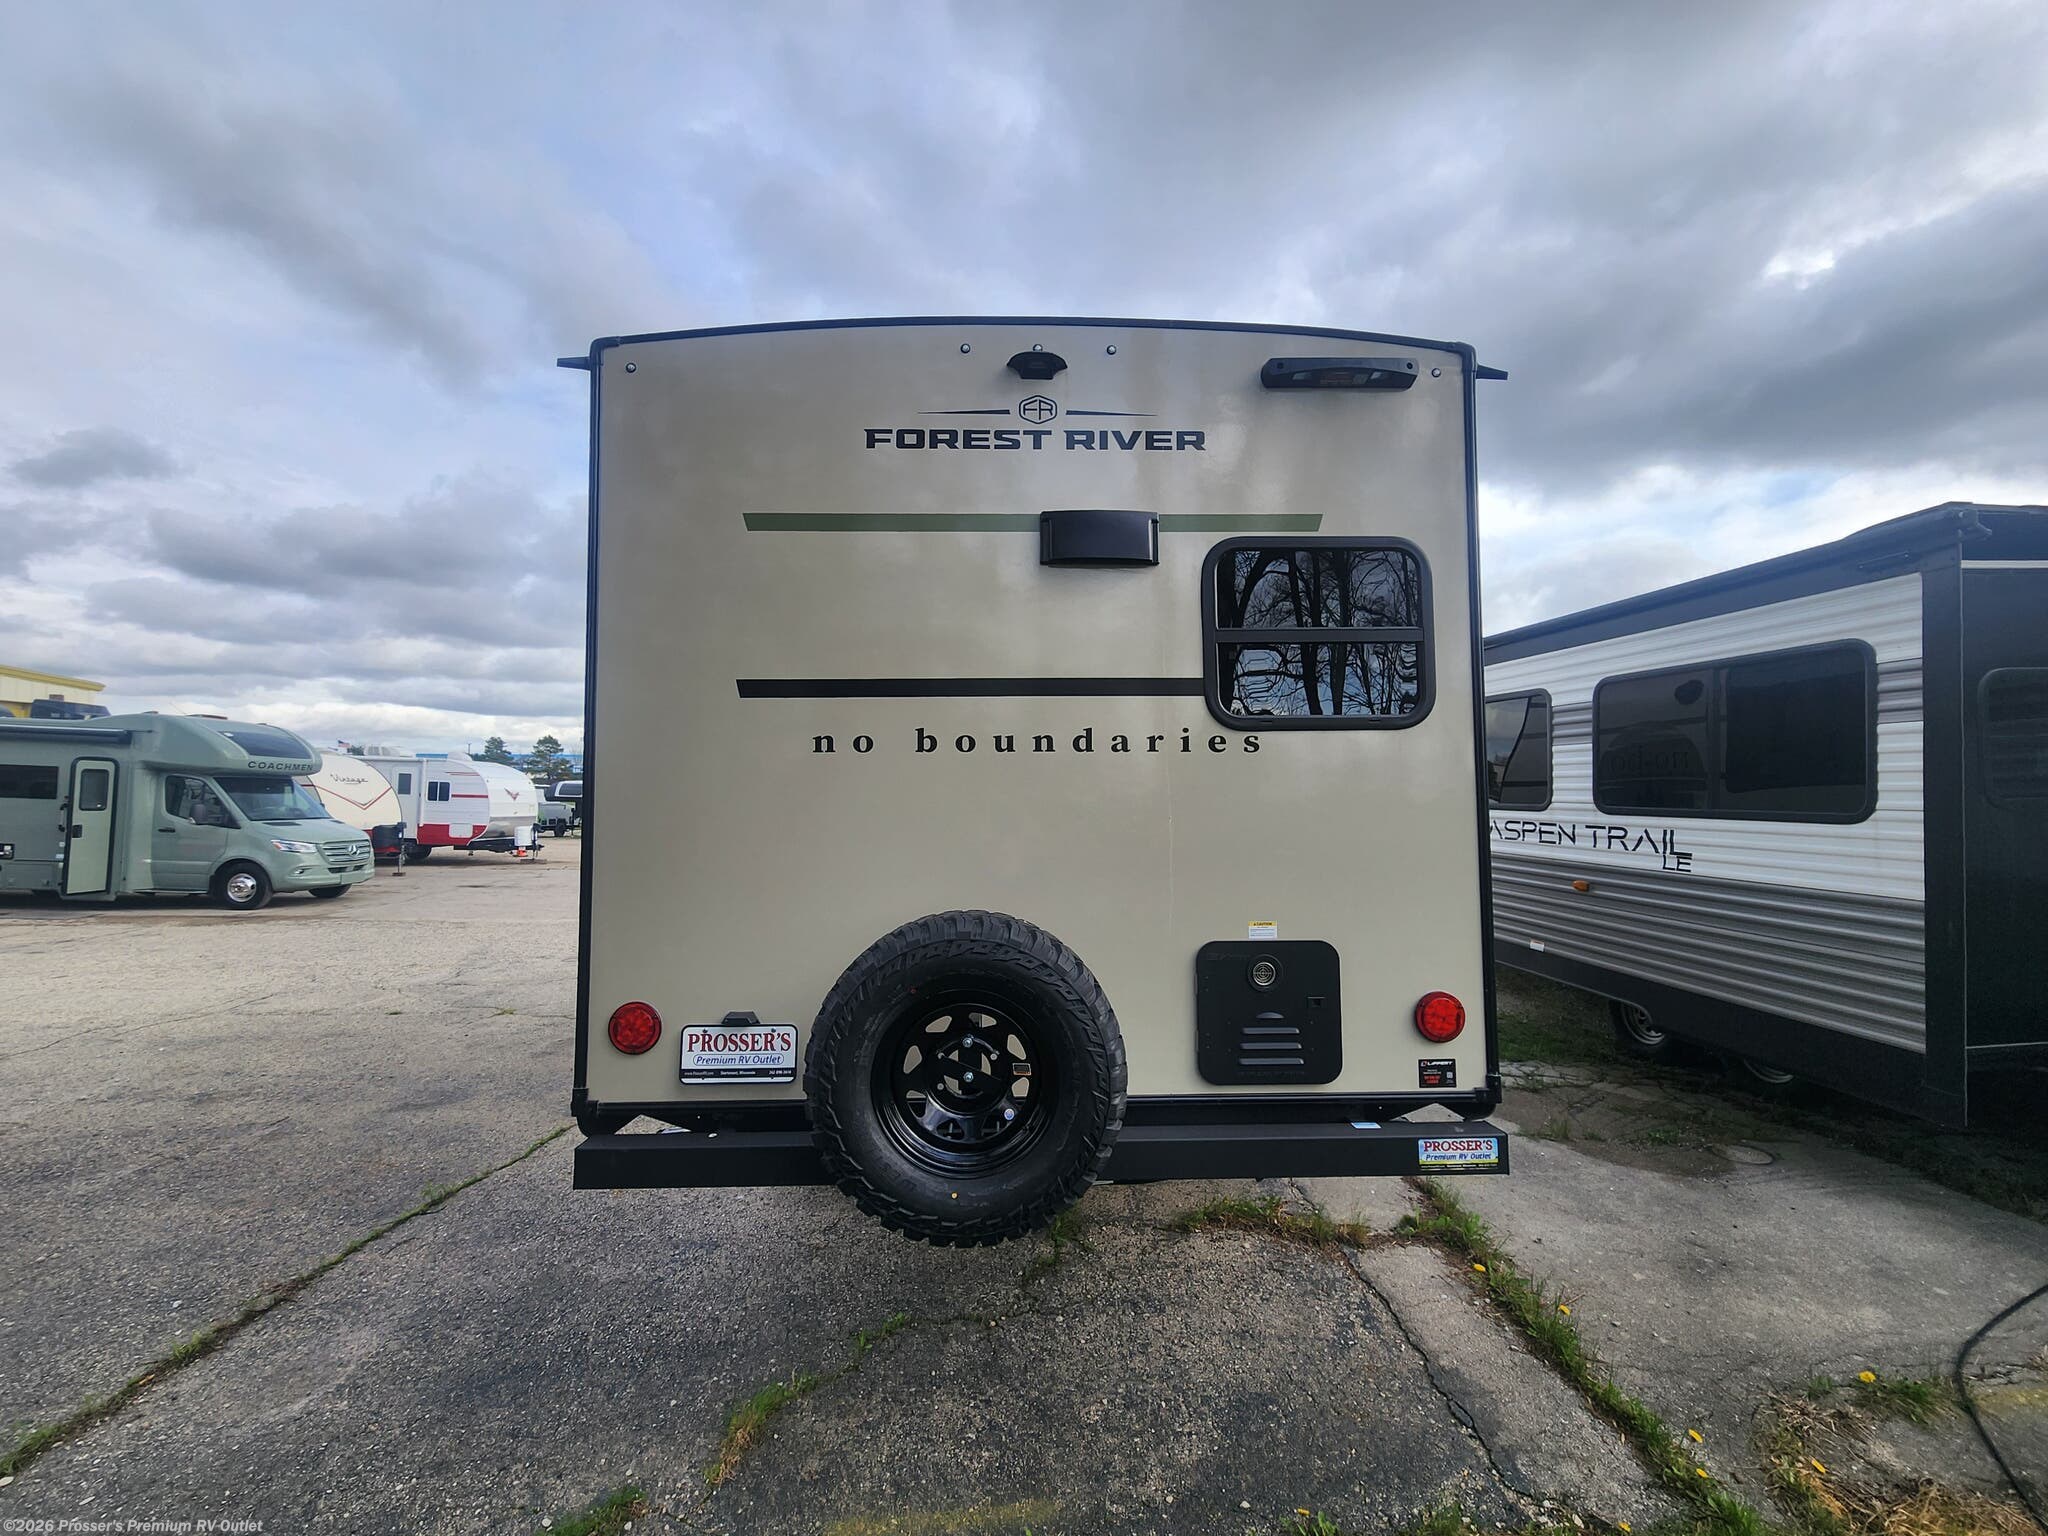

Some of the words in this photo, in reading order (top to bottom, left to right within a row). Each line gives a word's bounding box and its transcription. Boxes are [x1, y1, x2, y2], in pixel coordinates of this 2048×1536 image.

[865, 429, 1052, 451] FOREST
[1064, 429, 1206, 451] RIVER
[811, 732, 874, 754] no
[915, 727, 1261, 753] boundaries
[247, 760, 313, 771] COACHMEN
[330, 773, 369, 784] Vintage
[1490, 819, 1576, 846] ASPEN
[1585, 826, 1693, 856] TRAIL
[1662, 855, 1693, 873] LE
[687, 1032, 792, 1053] PROSSER'S
[696, 1055, 736, 1065] Premium
[738, 1055, 751, 1064] RV
[753, 1055, 781, 1064] Outlet
[1424, 1139, 1493, 1152] PROSSER'S
[1426, 1153, 1457, 1161] Premium
[1471, 1152, 1492, 1160] Outlet
